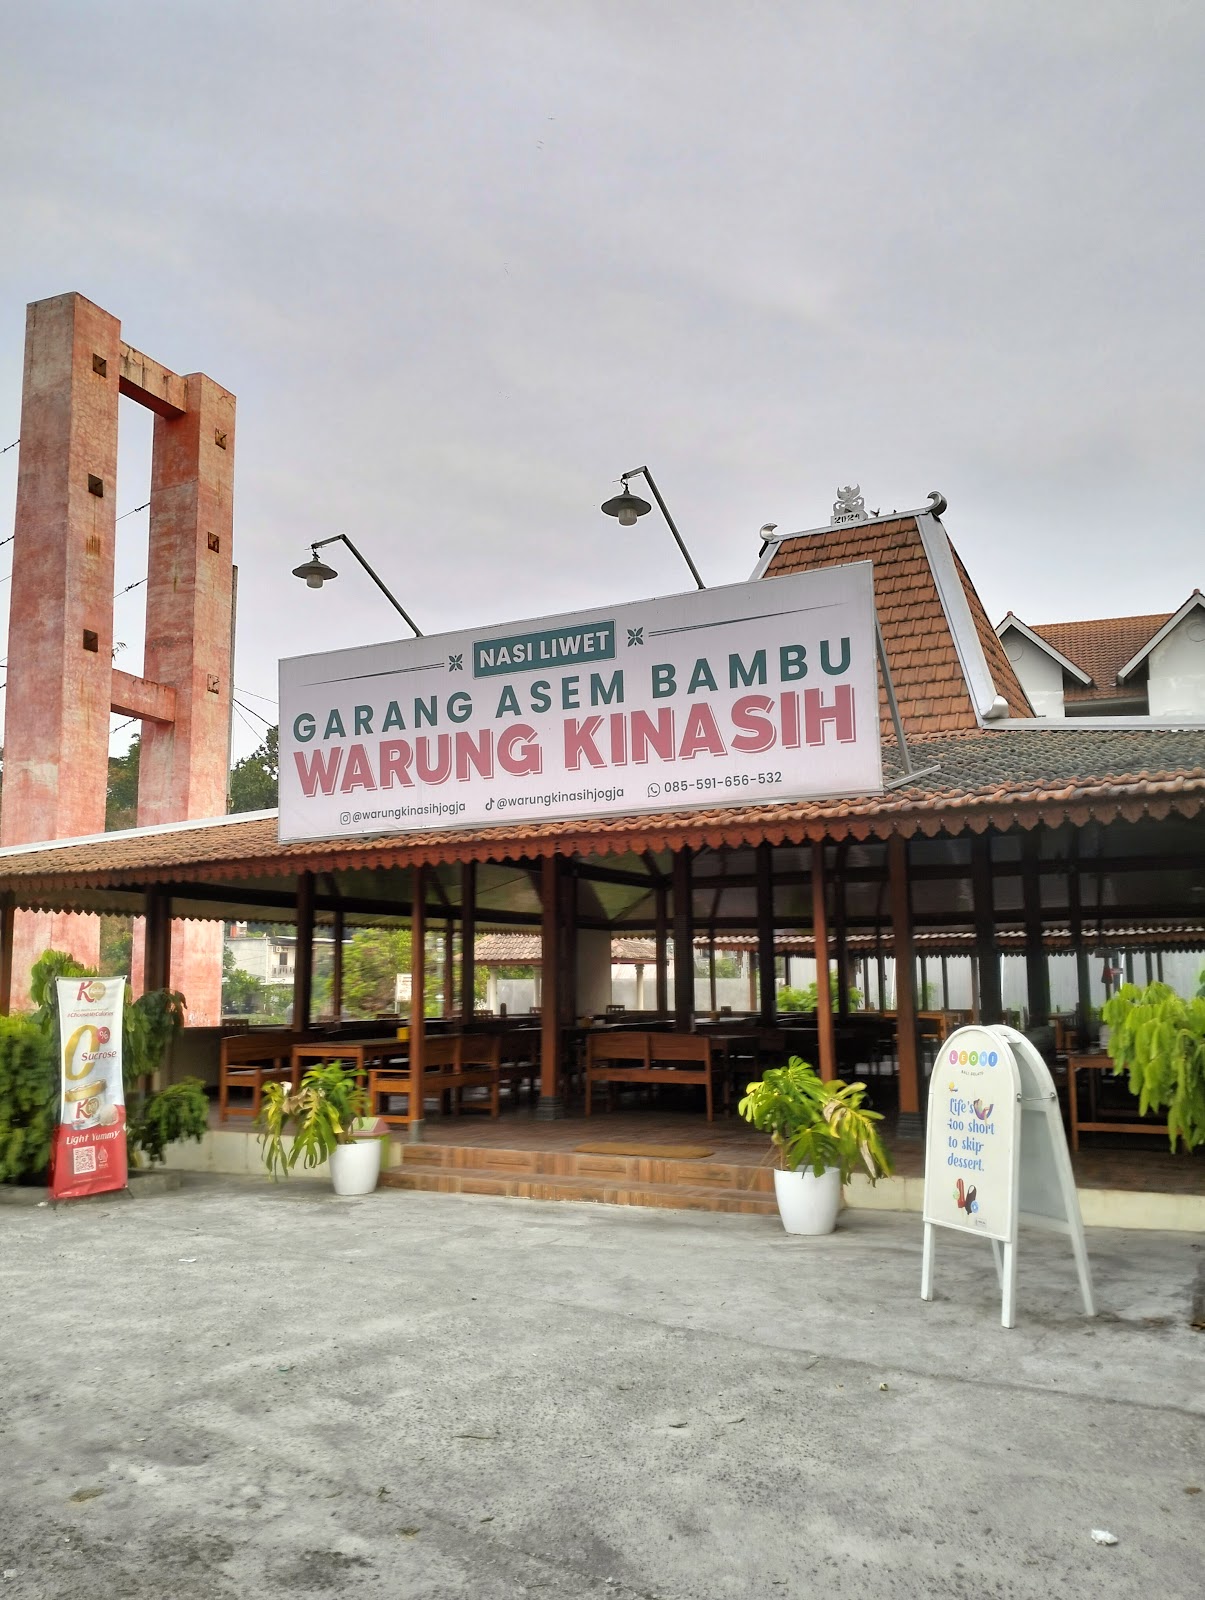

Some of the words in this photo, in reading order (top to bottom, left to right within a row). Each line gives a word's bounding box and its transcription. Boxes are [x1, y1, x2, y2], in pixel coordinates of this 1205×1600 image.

[479, 640, 533, 669] NASI
[540, 630, 611, 659] LIWET
[293, 690, 473, 743] GARANG
[495, 669, 625, 718] ASEM
[651, 636, 852, 699] BAMBU
[293, 723, 543, 798] WARUNG
[563, 683, 857, 771] KINASIH
[664, 771, 782, 793] 085-591-656-532
[496, 786, 625, 810] @warungkinasihjogja
[352, 801, 466, 823] @warungkinasihjogja
[81, 1050, 117, 1062] Sucrose
[950, 1052, 996, 1065] LEONI
[949, 1097, 974, 1115] Life's
[947, 1118, 964, 1131] too
[968, 1117, 995, 1135] short
[66, 1134, 89, 1145] Light
[92, 1130, 120, 1141] Yummy
[948, 1135, 958, 1148] to
[962, 1135, 984, 1155] skip
[947, 1153, 985, 1172] dessert.
